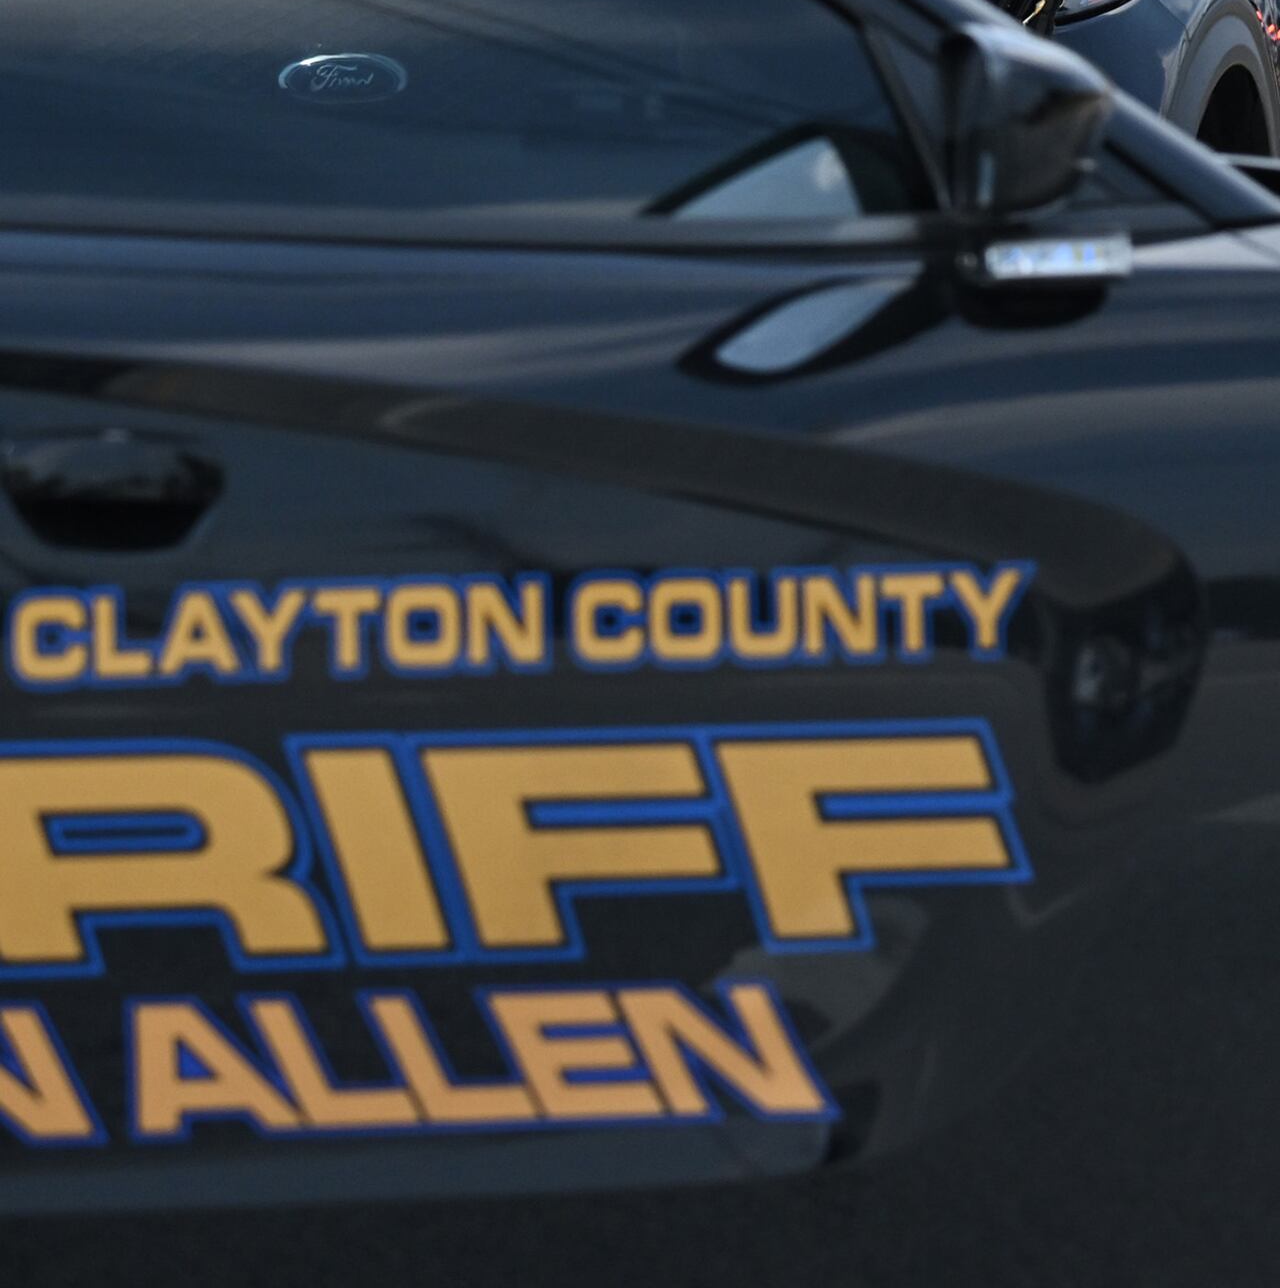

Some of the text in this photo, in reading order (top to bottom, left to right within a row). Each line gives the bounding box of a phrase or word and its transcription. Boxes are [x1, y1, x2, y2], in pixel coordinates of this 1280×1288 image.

[10, 560, 1036, 686] CLAYTON COUNTY
[0, 719, 1033, 977] RIFF
[124, 979, 842, 1140] ALLEN
